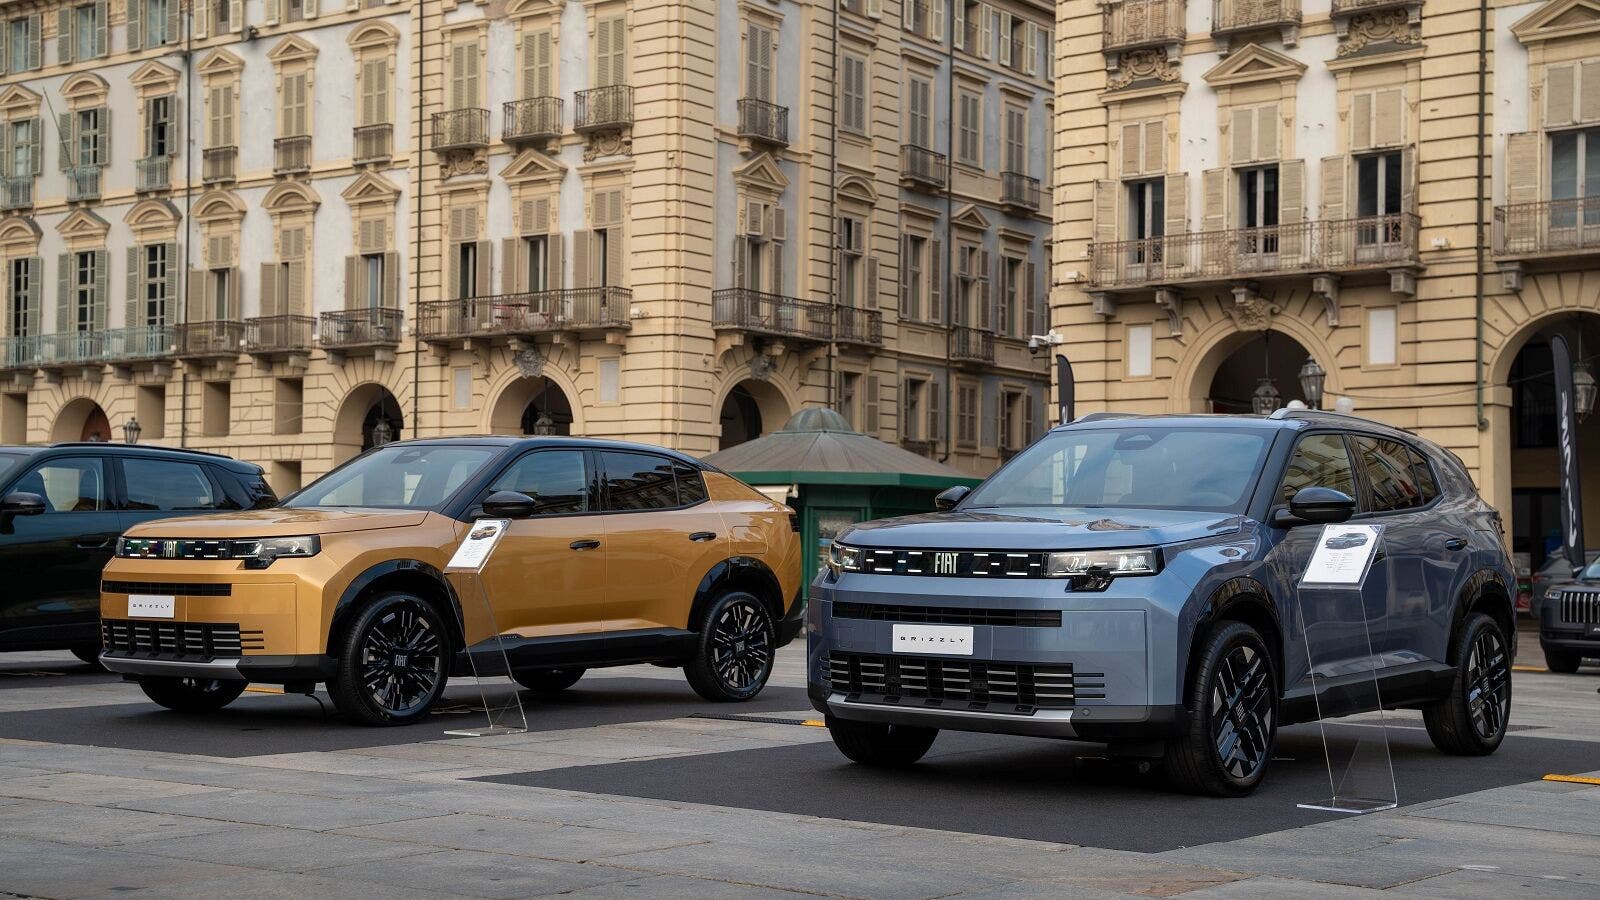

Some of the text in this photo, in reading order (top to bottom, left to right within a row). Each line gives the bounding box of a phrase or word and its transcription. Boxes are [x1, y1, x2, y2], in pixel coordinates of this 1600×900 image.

[163, 540, 177, 558] FIAT
[934, 552, 959, 574] FIAT
[394, 654, 407, 667] FIAT
